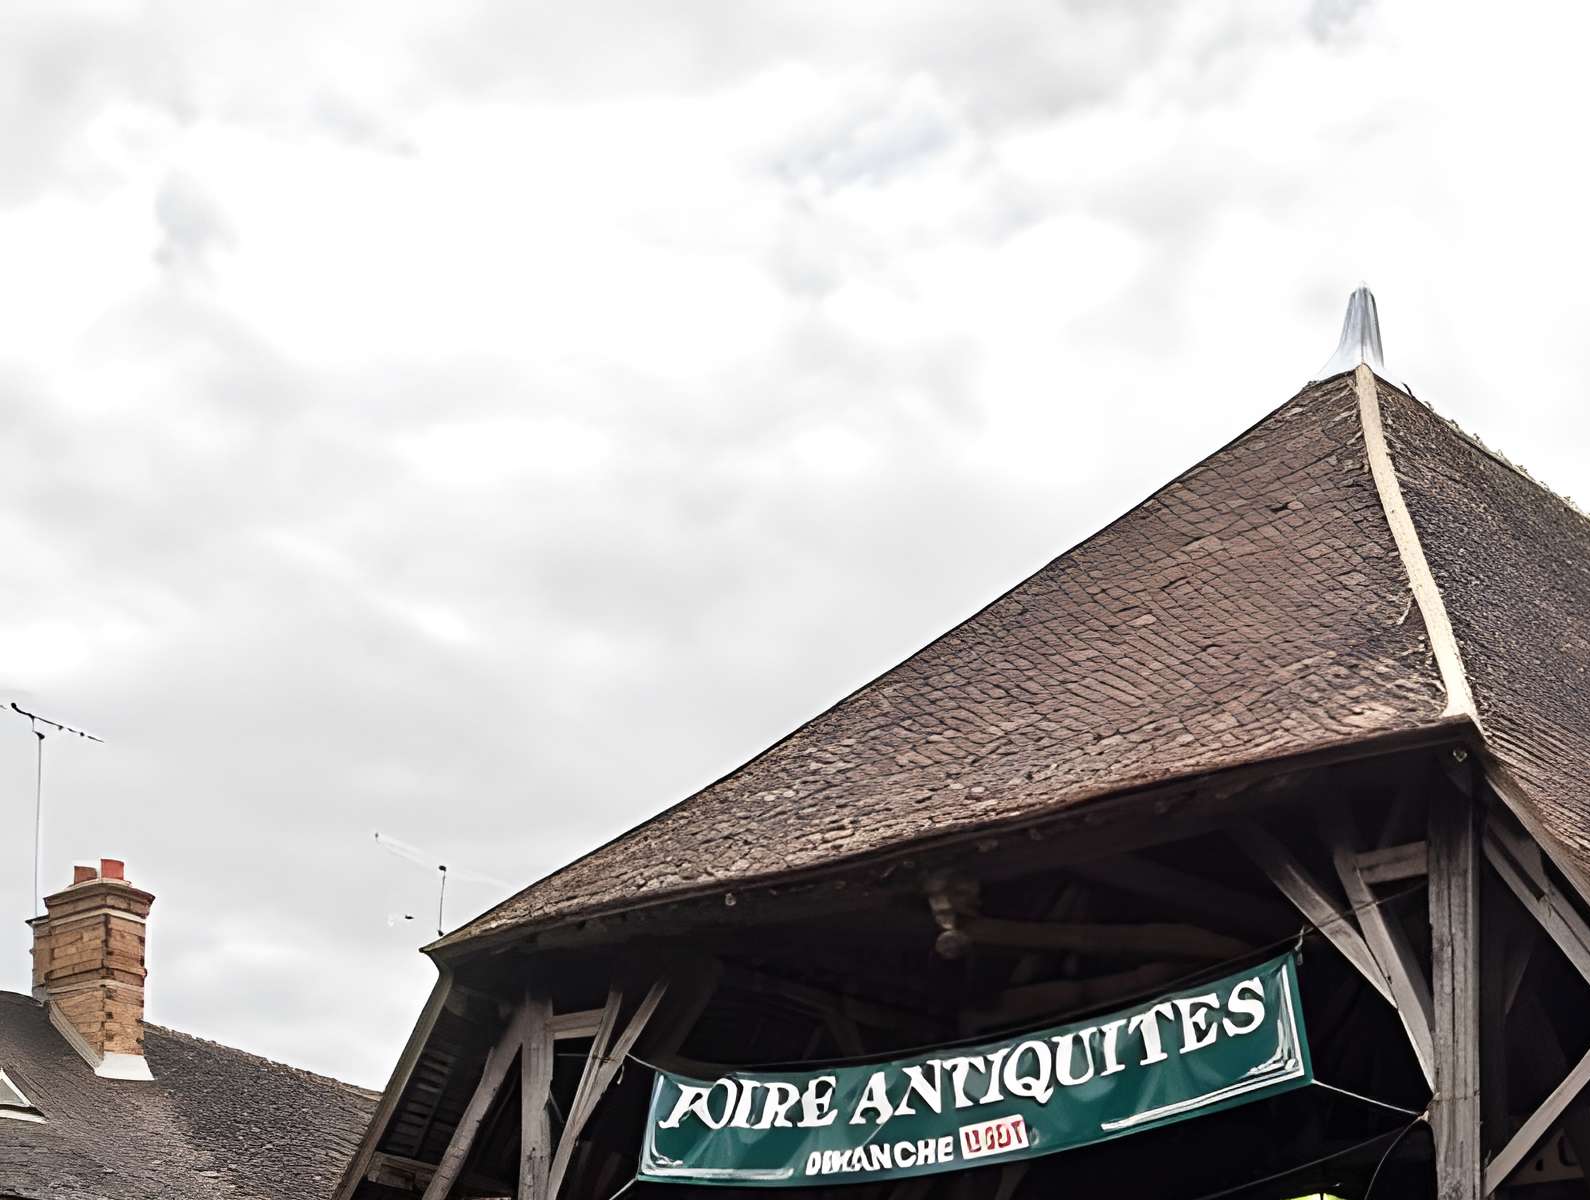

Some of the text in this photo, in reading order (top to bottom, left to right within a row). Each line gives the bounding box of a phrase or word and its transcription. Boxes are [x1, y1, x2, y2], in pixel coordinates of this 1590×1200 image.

[658, 976, 1266, 1129] FOIRE ANTIQUITES
[805, 1136, 953, 1175] DIMANCHE
